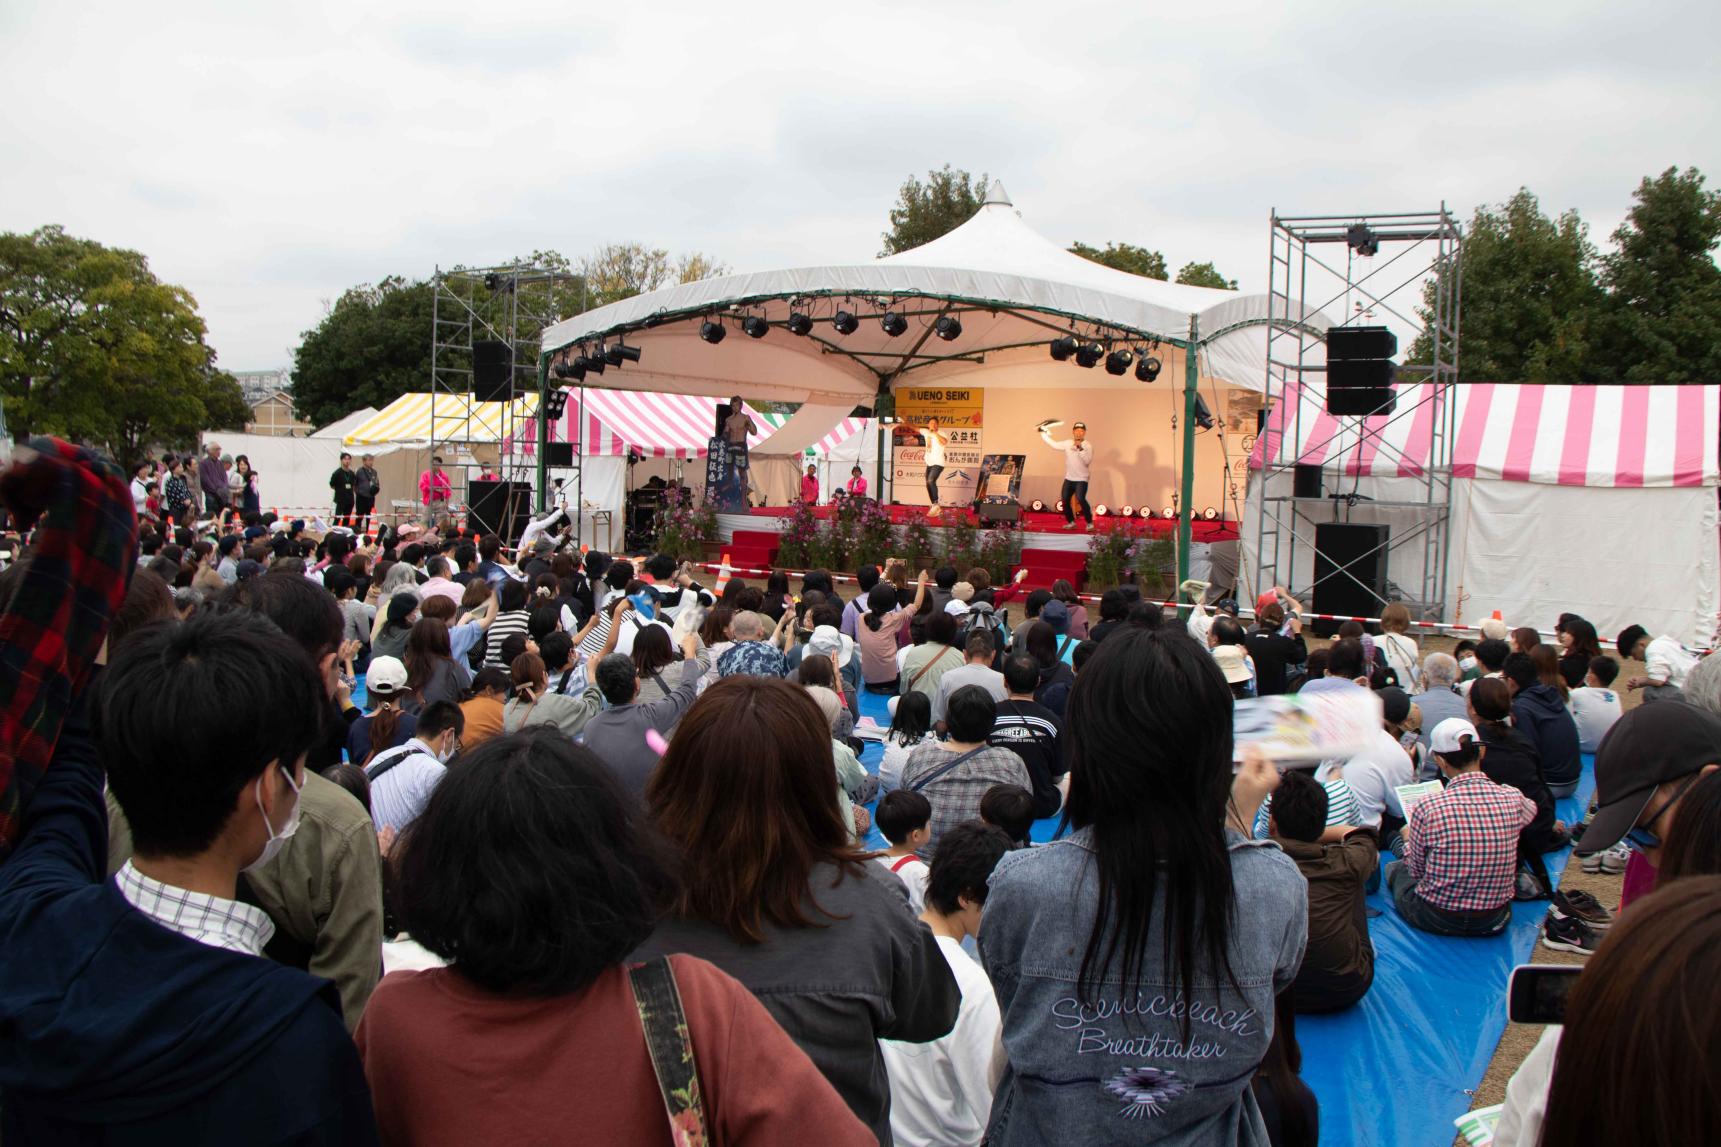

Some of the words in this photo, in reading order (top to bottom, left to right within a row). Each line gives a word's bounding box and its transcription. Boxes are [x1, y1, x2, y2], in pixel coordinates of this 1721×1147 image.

[917, 390, 943, 401] UENO
[945, 390, 970, 401] SEIKI
[950, 431, 978, 441] 公益社
[1078, 1028, 1228, 1060] Breathtaker
